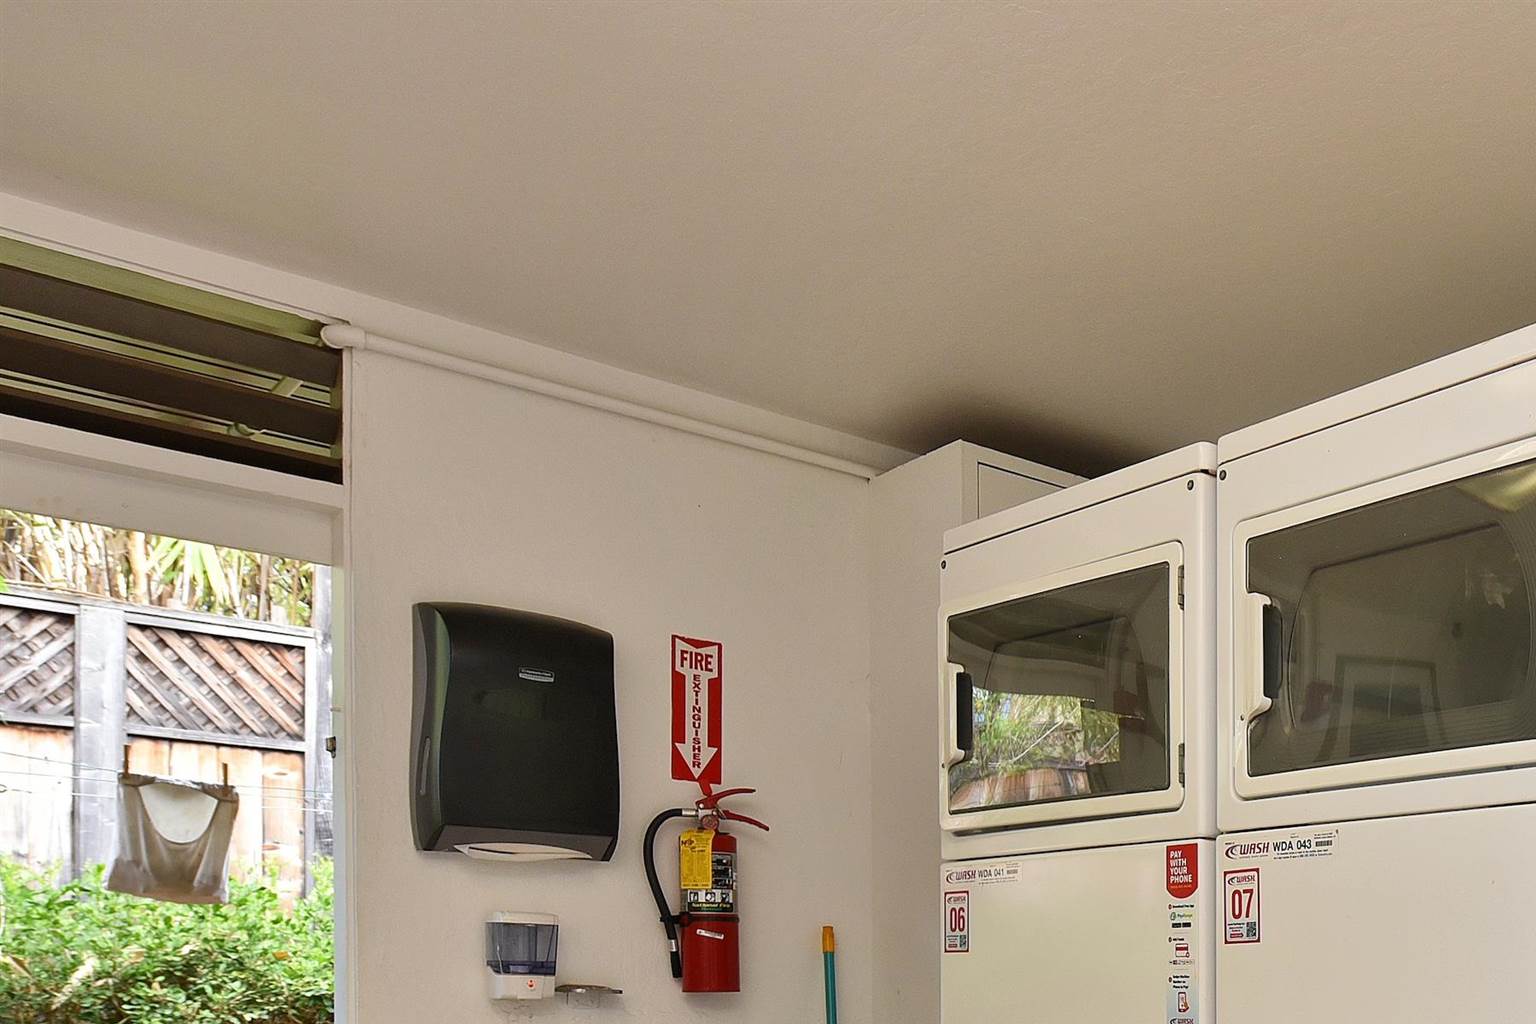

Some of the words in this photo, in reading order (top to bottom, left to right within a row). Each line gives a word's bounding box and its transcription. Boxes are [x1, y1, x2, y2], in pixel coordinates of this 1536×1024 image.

[679, 648, 714, 673] FIRE
[691, 673, 702, 769] EXTINGUISHER
[1239, 841, 1270, 855] WASH
[1272, 841, 1294, 852] WDA
[1296, 839, 1312, 850] 043
[1169, 849, 1183, 860] PAY
[1169, 858, 1188, 867] WITH
[977, 869, 993, 879] WDA
[1169, 866, 1188, 875] YOUR
[1169, 873, 1193, 884] PHONE
[1231, 888, 1255, 920] 07
[949, 906, 966, 933] 06
